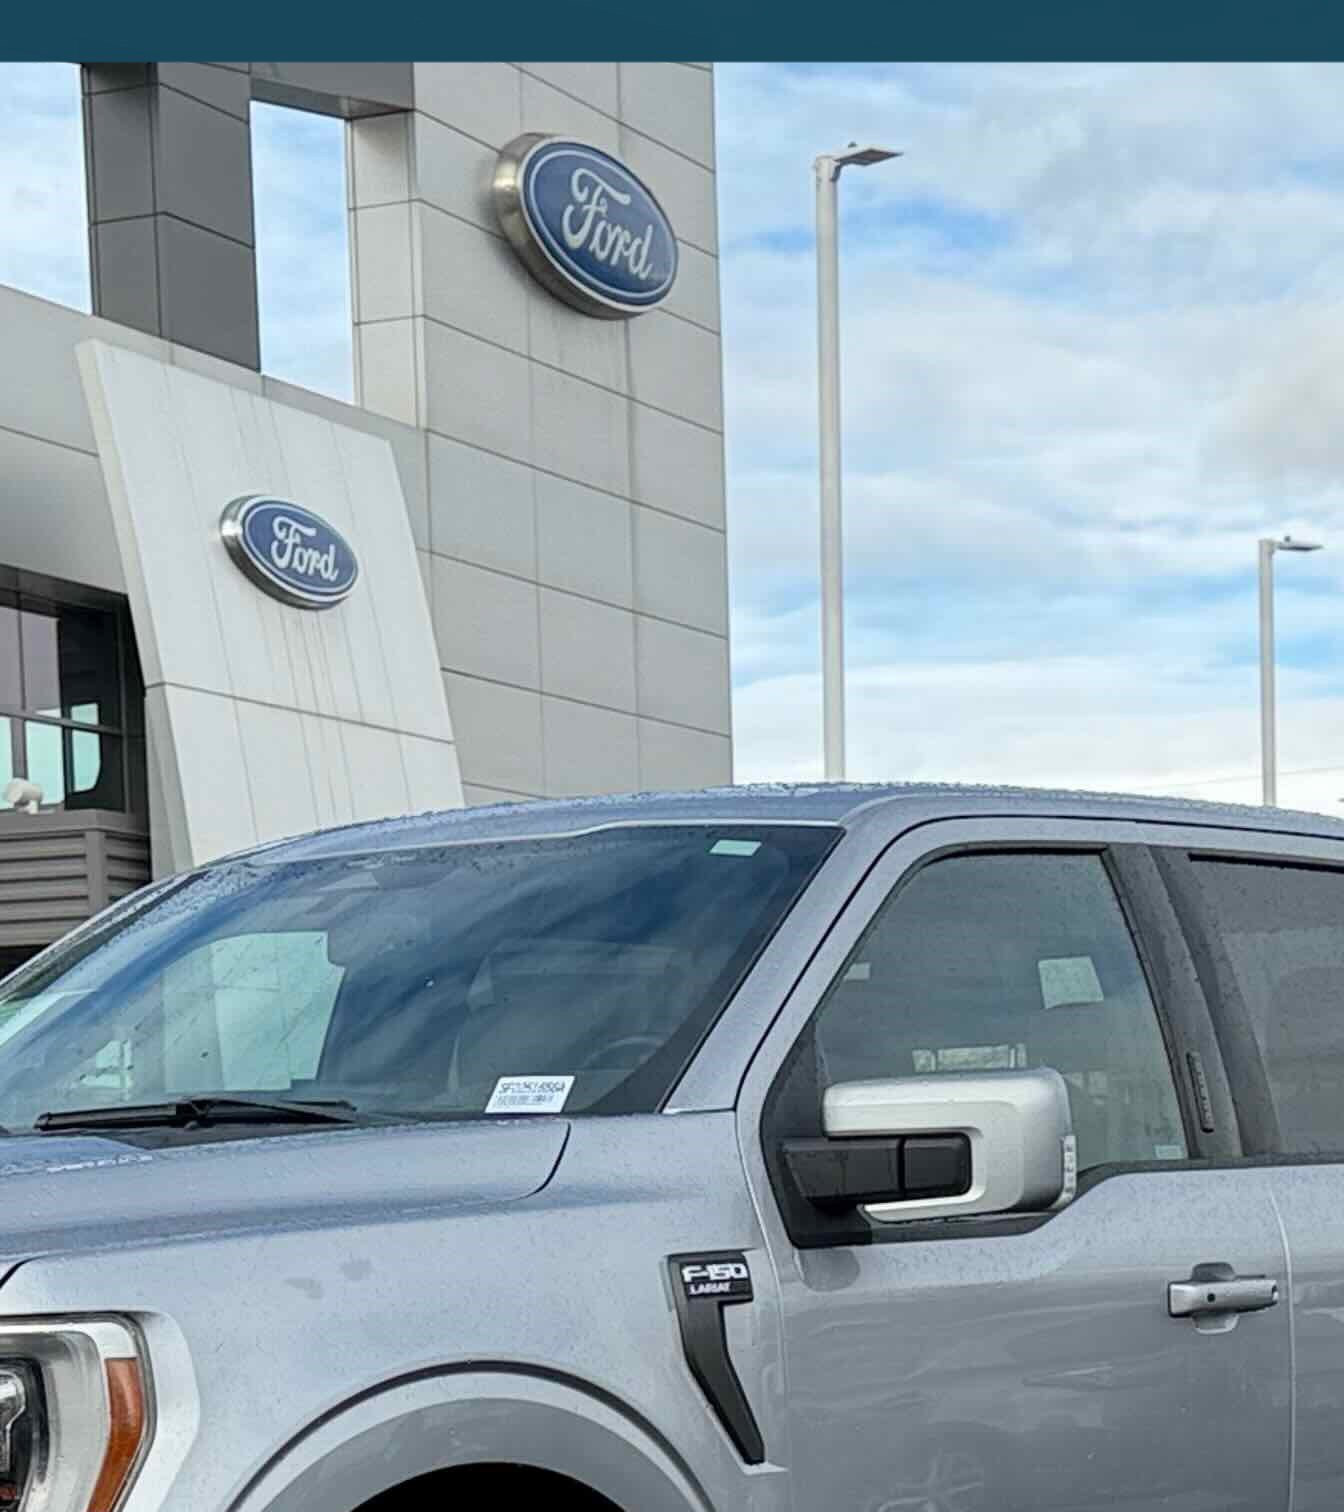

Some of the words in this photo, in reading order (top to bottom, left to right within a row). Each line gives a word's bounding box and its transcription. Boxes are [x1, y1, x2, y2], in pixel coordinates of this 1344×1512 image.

[561, 167, 654, 281] Ford
[270, 514, 340, 583] Ford
[681, 1262, 749, 1283] F-150
